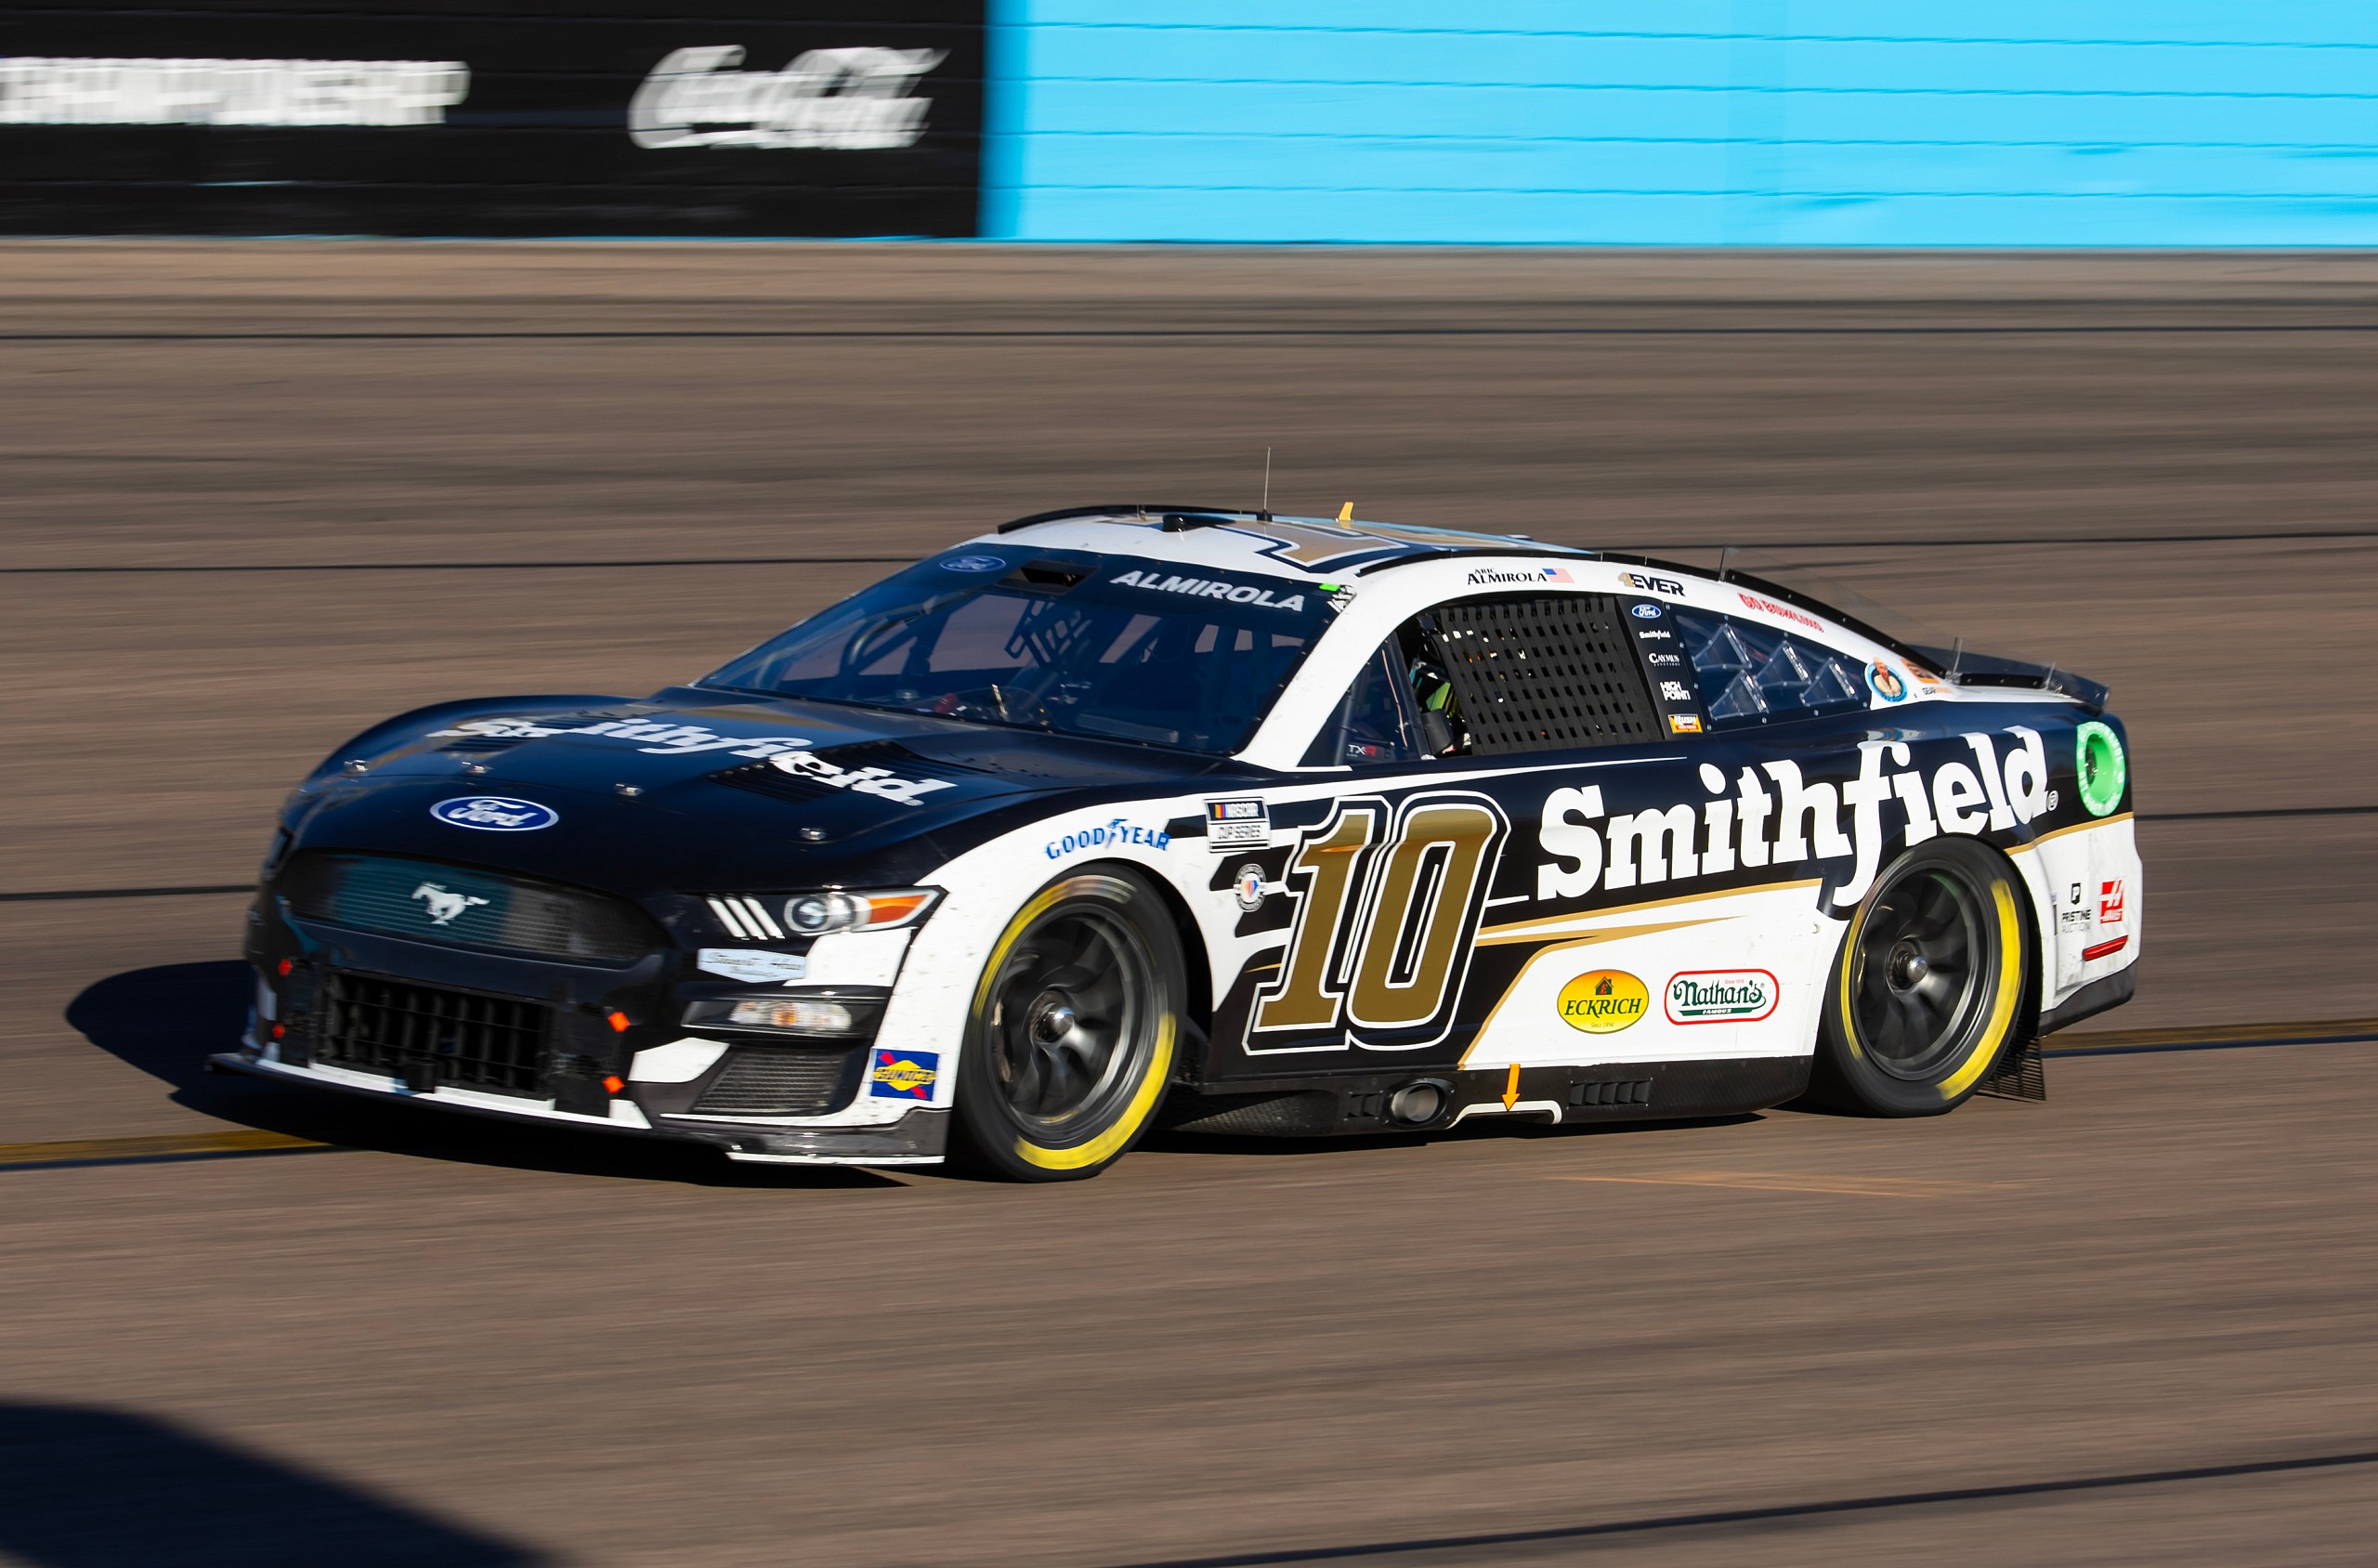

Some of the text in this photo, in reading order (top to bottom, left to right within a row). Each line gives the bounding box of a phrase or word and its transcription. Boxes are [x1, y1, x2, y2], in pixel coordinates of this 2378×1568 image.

[1109, 569, 1305, 612] ALMIROLA
[1468, 570, 1547, 585] ALMIROLA
[1618, 571, 1686, 597] 4EVER
[447, 798, 539, 827] Ford
[1536, 725, 2048, 907] Smithfield
[1045, 819, 1171, 860] GOODYEAR
[1250, 802, 1499, 1034] 10
[1673, 979, 1764, 1007] Nathan's
[1564, 998, 1642, 1019] ECKRICH
